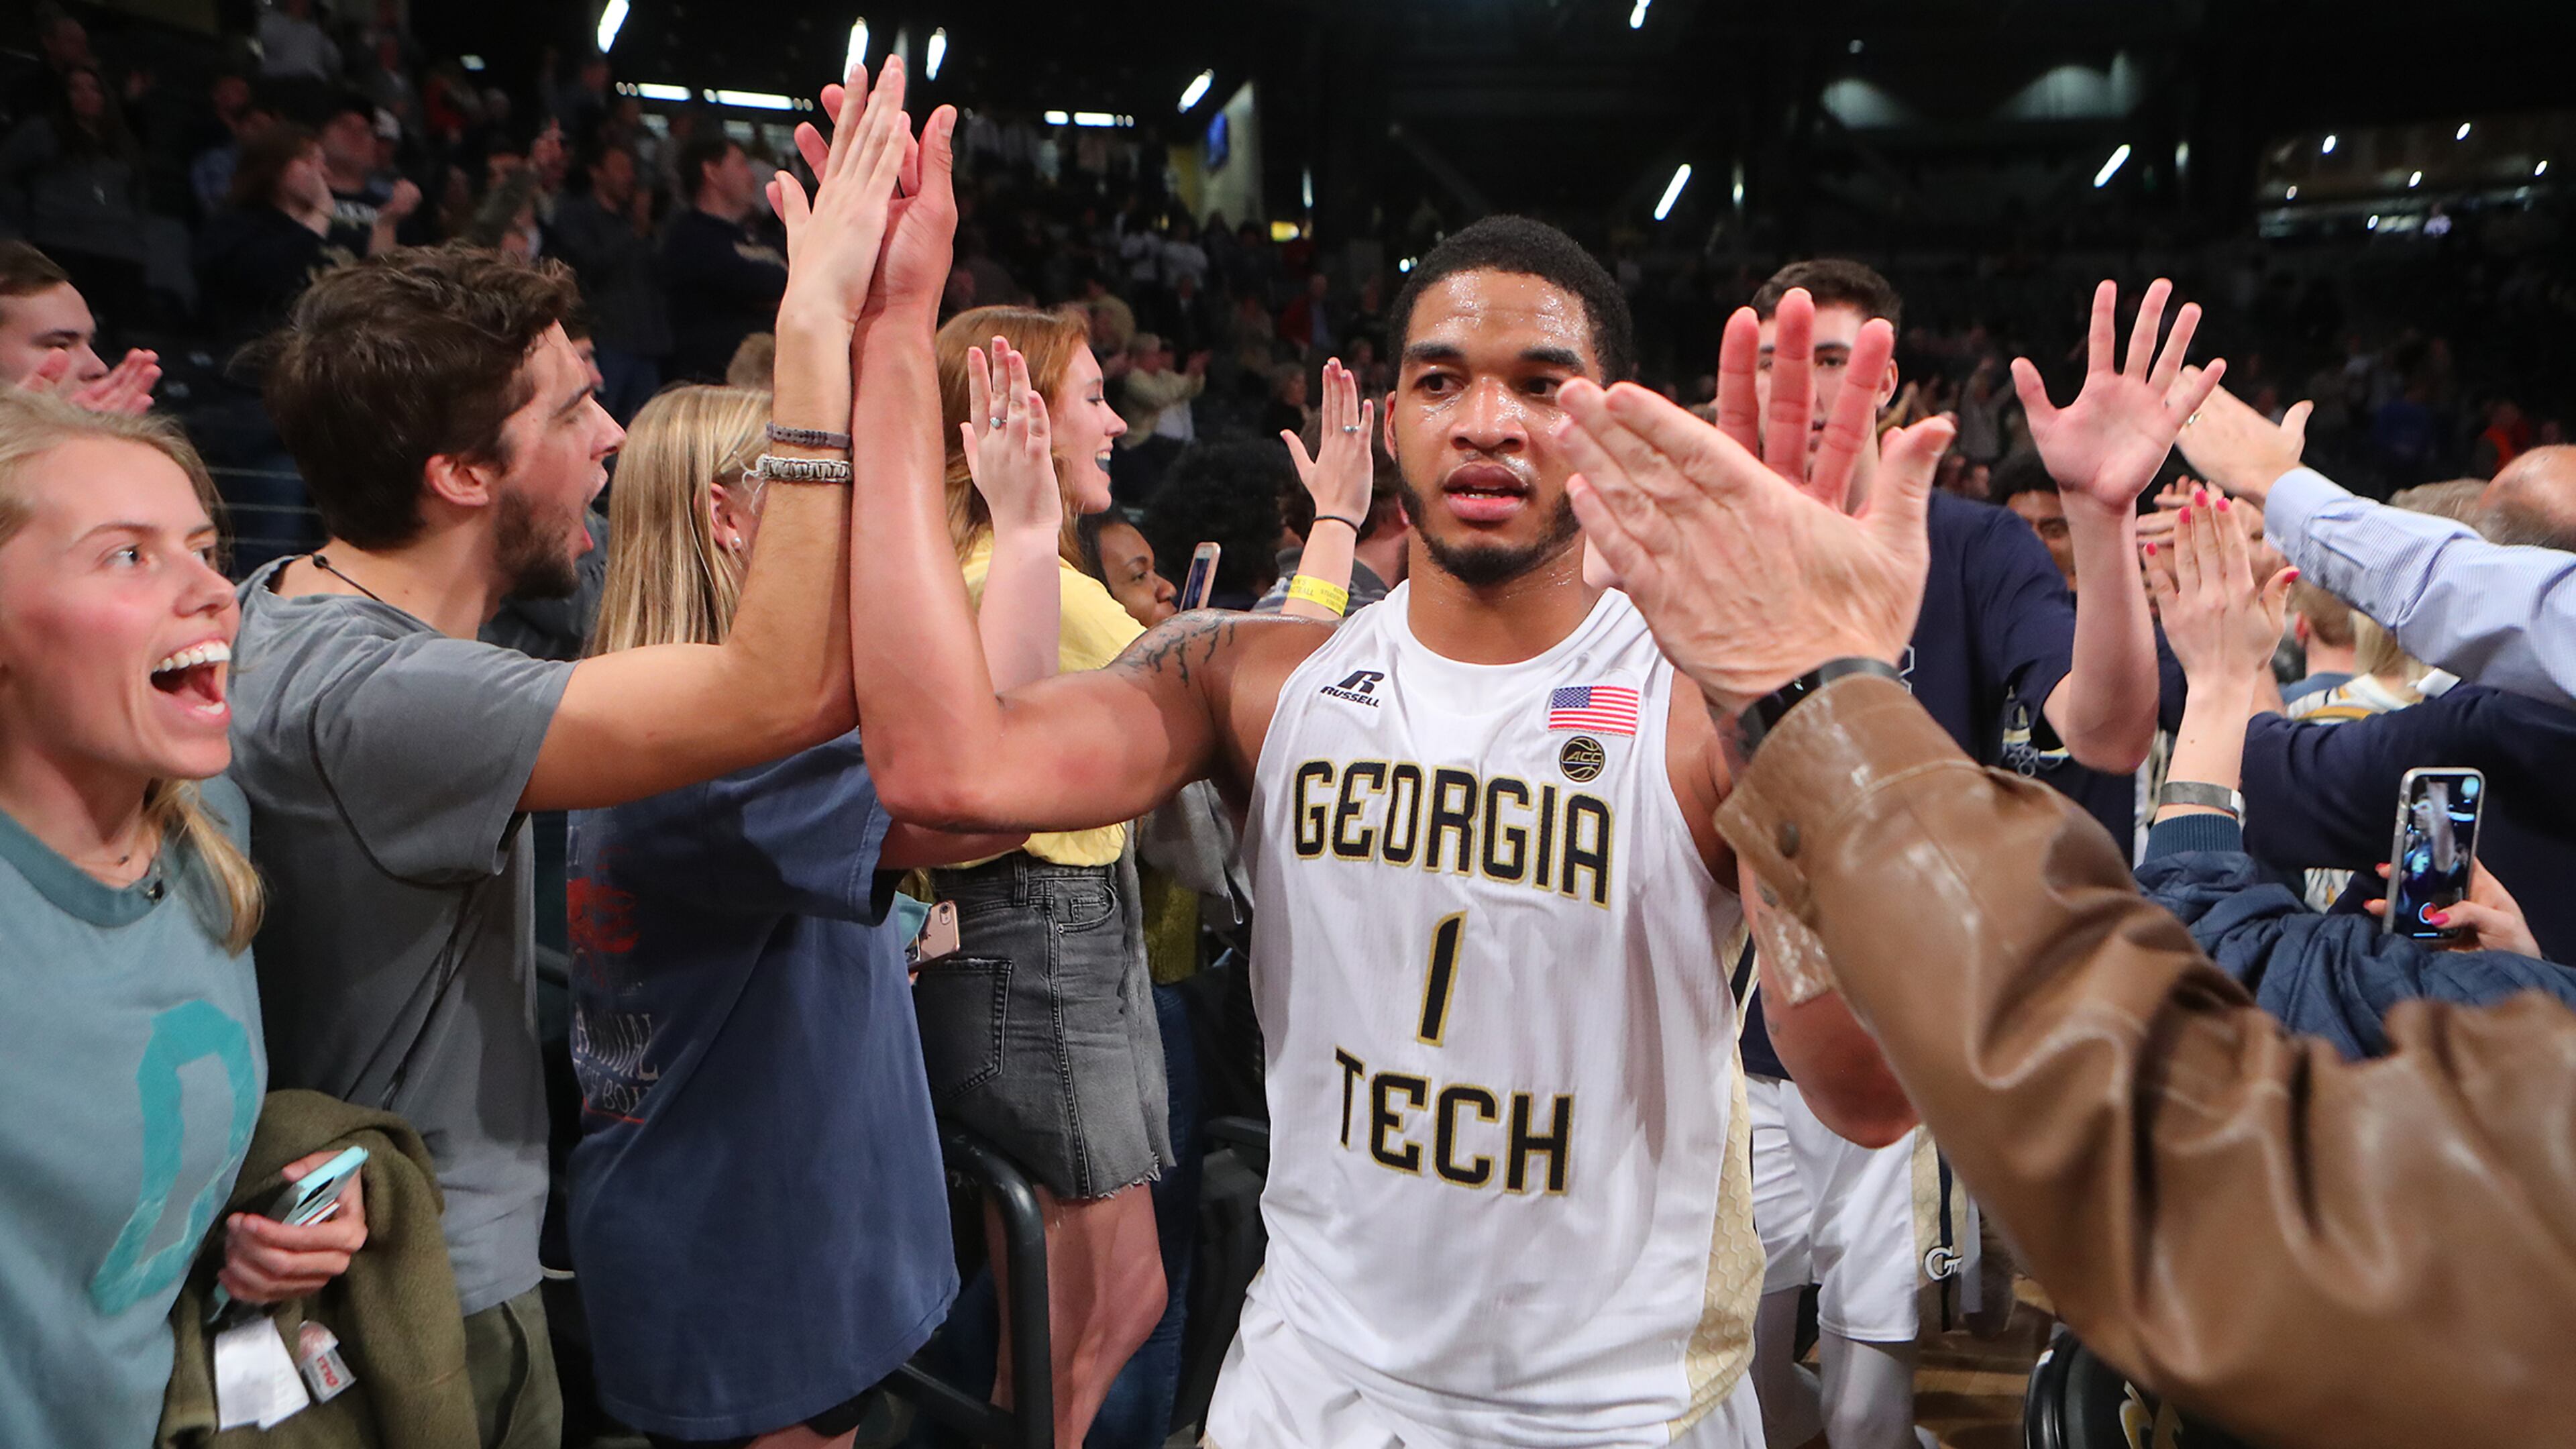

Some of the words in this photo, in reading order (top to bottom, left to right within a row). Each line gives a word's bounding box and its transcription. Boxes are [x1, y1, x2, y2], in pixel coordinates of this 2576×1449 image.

[1320, 686, 1379, 708] RUSSELL
[1565, 751, 1603, 763] ACC
[1294, 759, 1615, 910] GEORGIA
[1416, 910, 1468, 1047] 1
[1335, 1044, 1575, 1196] TECH
